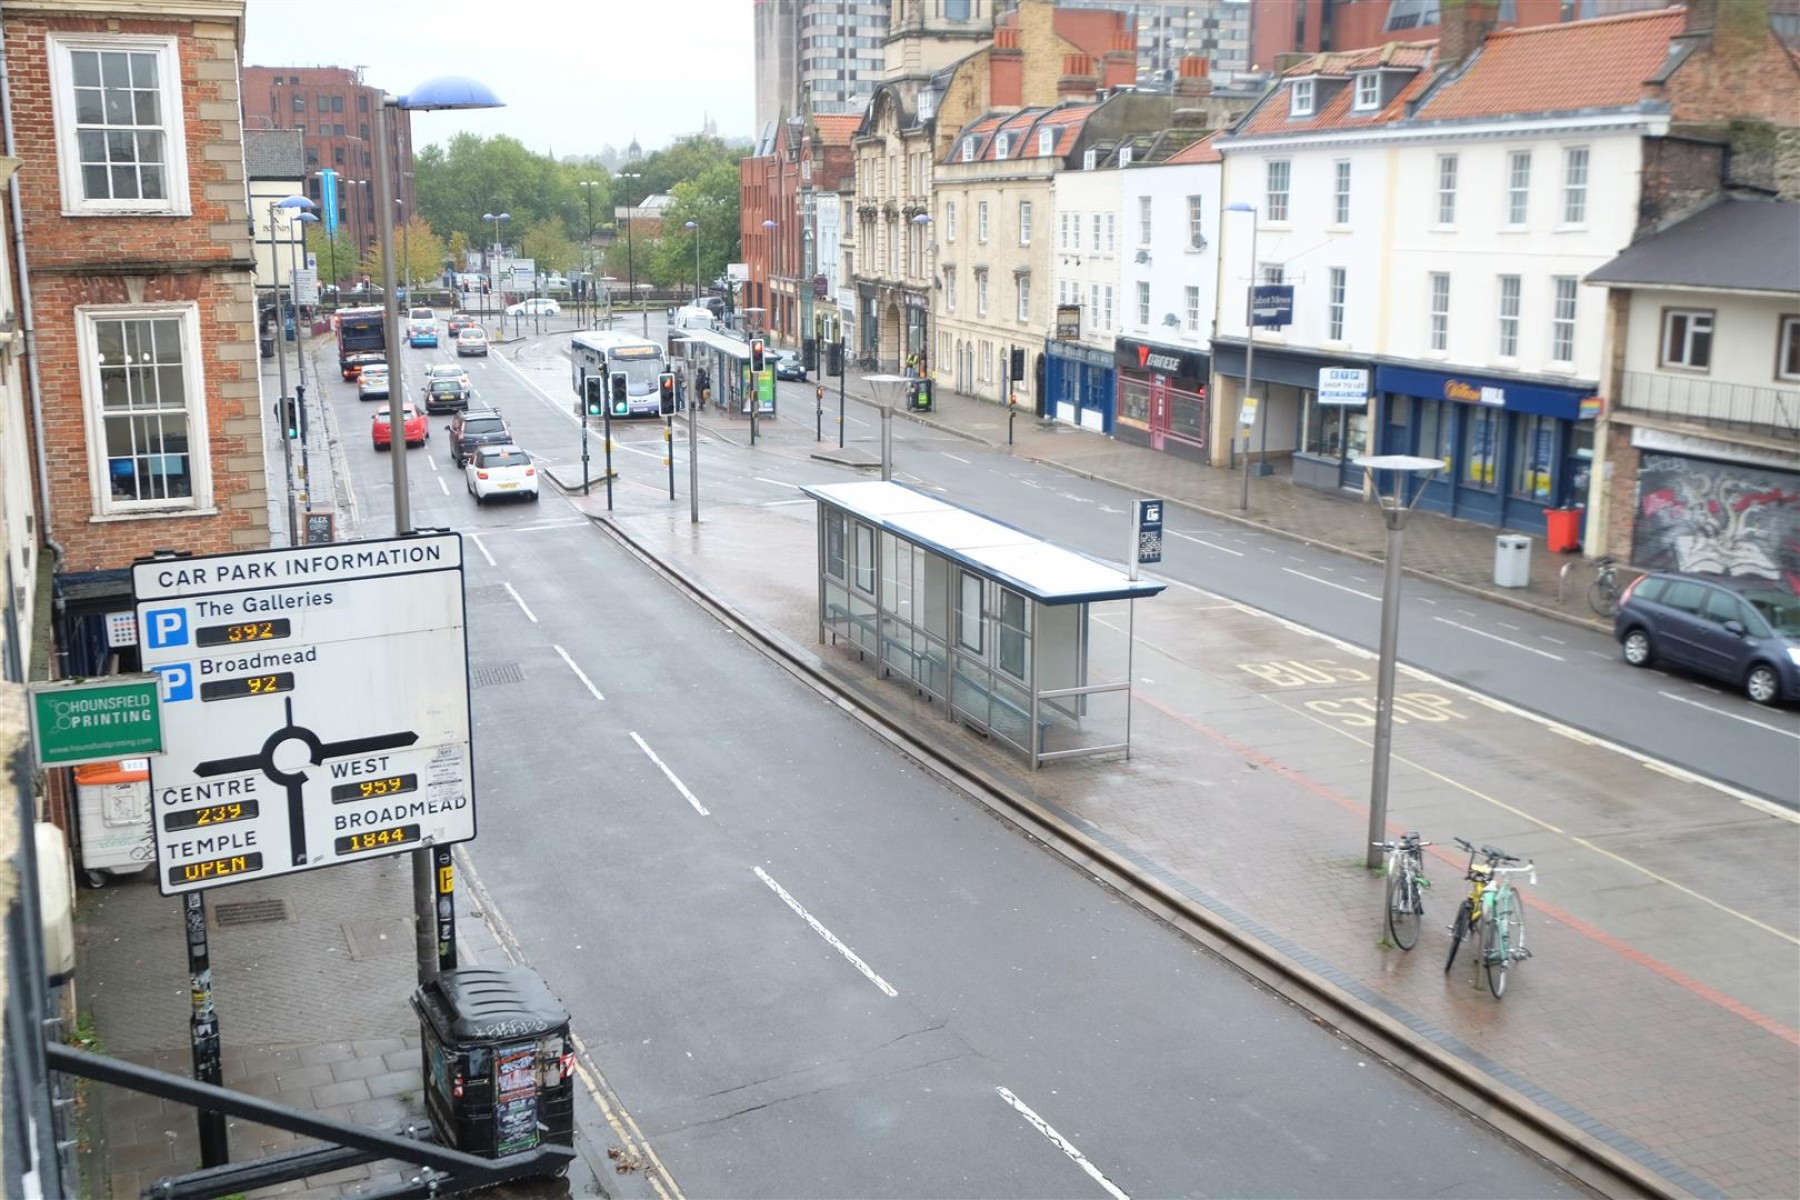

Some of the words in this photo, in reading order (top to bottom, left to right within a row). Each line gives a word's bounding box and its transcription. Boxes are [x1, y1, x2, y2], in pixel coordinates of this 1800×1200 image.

[1481, 386, 1505, 405] HILL
[158, 568, 207, 588] CAR
[217, 561, 277, 583] PARK
[286, 545, 441, 576] INFORMATION
[195, 601, 234, 618] The
[243, 591, 334, 613] Galleries
[155, 612, 182, 645] P
[227, 622, 274, 642] 392
[200, 646, 317, 675] Broadmead
[1235, 658, 1372, 688] BUS
[161, 667, 186, 699] P
[247, 675, 277, 693] 92
[70, 694, 151, 713] HOUNSFIELD
[1303, 692, 1468, 727] STOP
[71, 709, 152, 728] PRINTING
[331, 756, 390, 779] WEST
[163, 777, 257, 806] CENTRE
[359, 777, 401, 797] 959
[196, 803, 242, 825] 239
[335, 796, 467, 831] BROADMEAD
[166, 830, 257, 860] TEMPLE
[350, 828, 405, 851] 1844
[185, 856, 247, 881] OPEN
